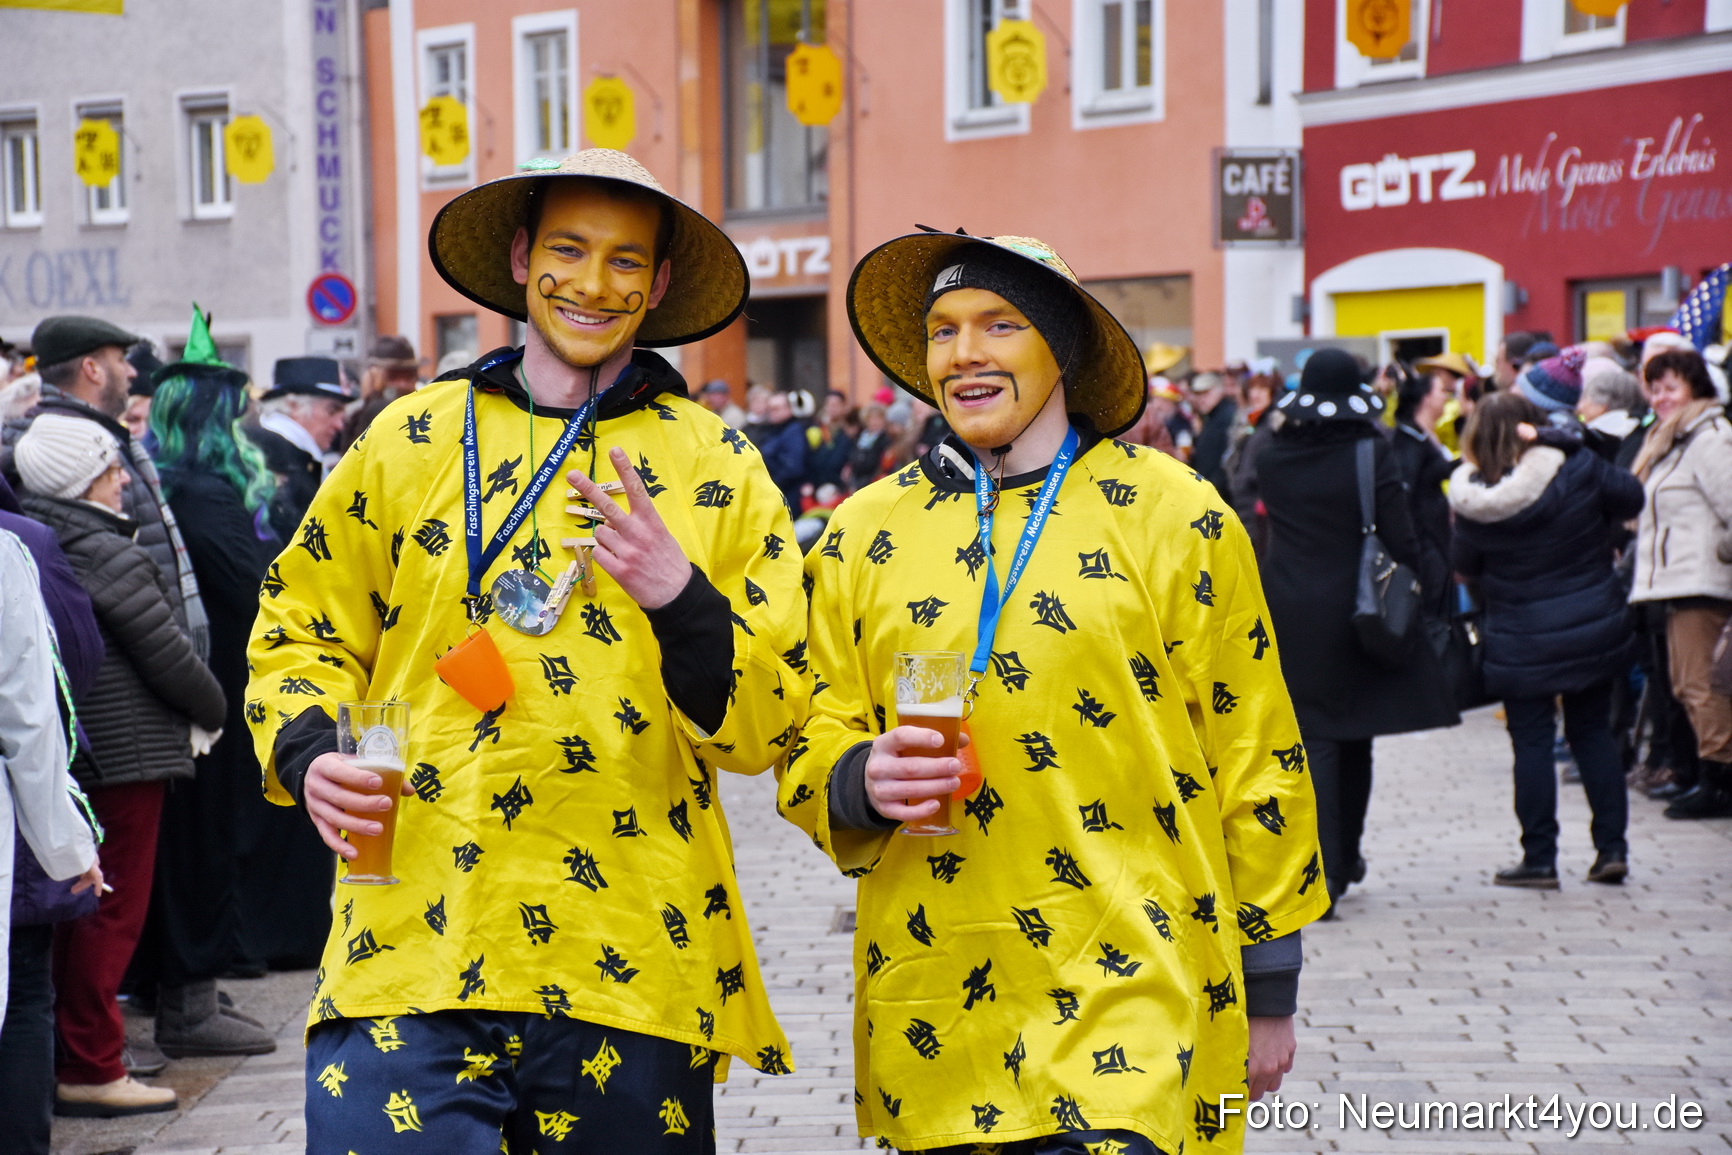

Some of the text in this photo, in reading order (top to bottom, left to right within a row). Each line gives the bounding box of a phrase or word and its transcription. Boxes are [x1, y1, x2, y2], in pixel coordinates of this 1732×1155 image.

[316, 56, 341, 270] SCHMUCK
[1223, 157, 1290, 196] CAFÉ
[1630, 112, 1718, 181] Erlebnis
[25, 246, 133, 309] OEXL
[734, 235, 831, 279] ÖTZ
[465, 449, 480, 537] Faschingsverein
[495, 466, 553, 543] Faschingsverein
[1026, 471, 1062, 538] Meckenhausen
[1057, 451, 1071, 470] e.V.
